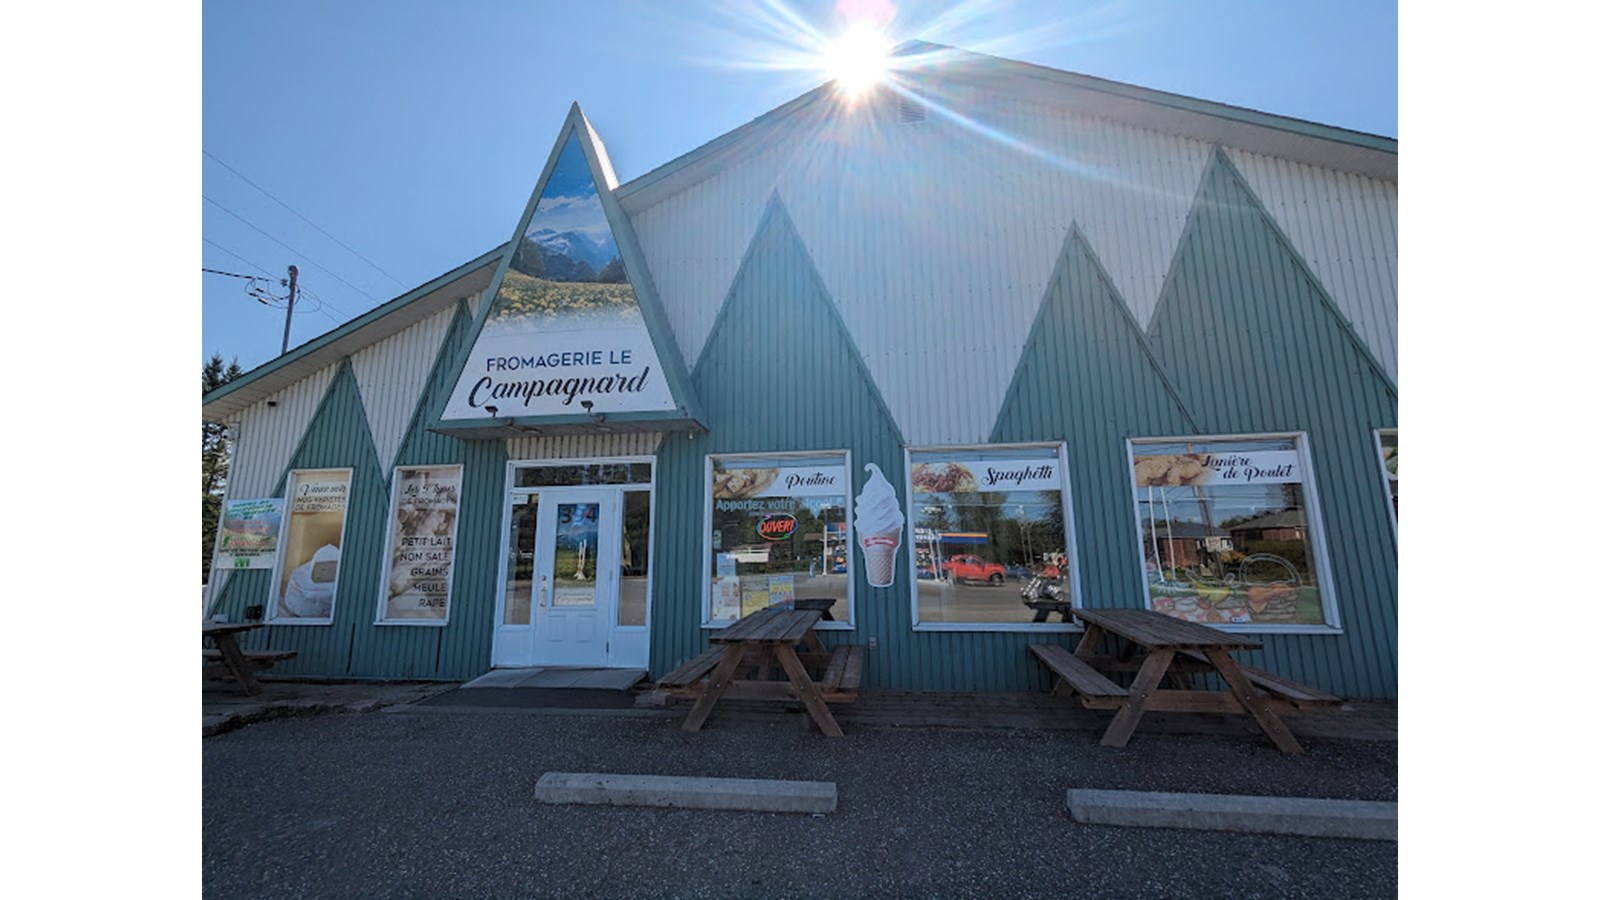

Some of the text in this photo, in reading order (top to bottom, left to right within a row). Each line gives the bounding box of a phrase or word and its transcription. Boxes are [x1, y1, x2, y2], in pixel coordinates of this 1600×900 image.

[487, 350, 632, 372] FROMAGERIE LE
[468, 366, 650, 408] Campagnard
[982, 464, 1055, 486] Spaghetti
[1223, 464, 1296, 481] de Poulet
[785, 472, 836, 489] Poutine
[716, 499, 766, 511] Apportez
[767, 498, 796, 509] votre
[759, 519, 796, 534] OUVERT
[401, 537, 452, 547] PETIT LAIT
[400, 552, 423, 561] NON
[410, 567, 449, 577] GRAINS
[412, 583, 447, 592] MEULE
